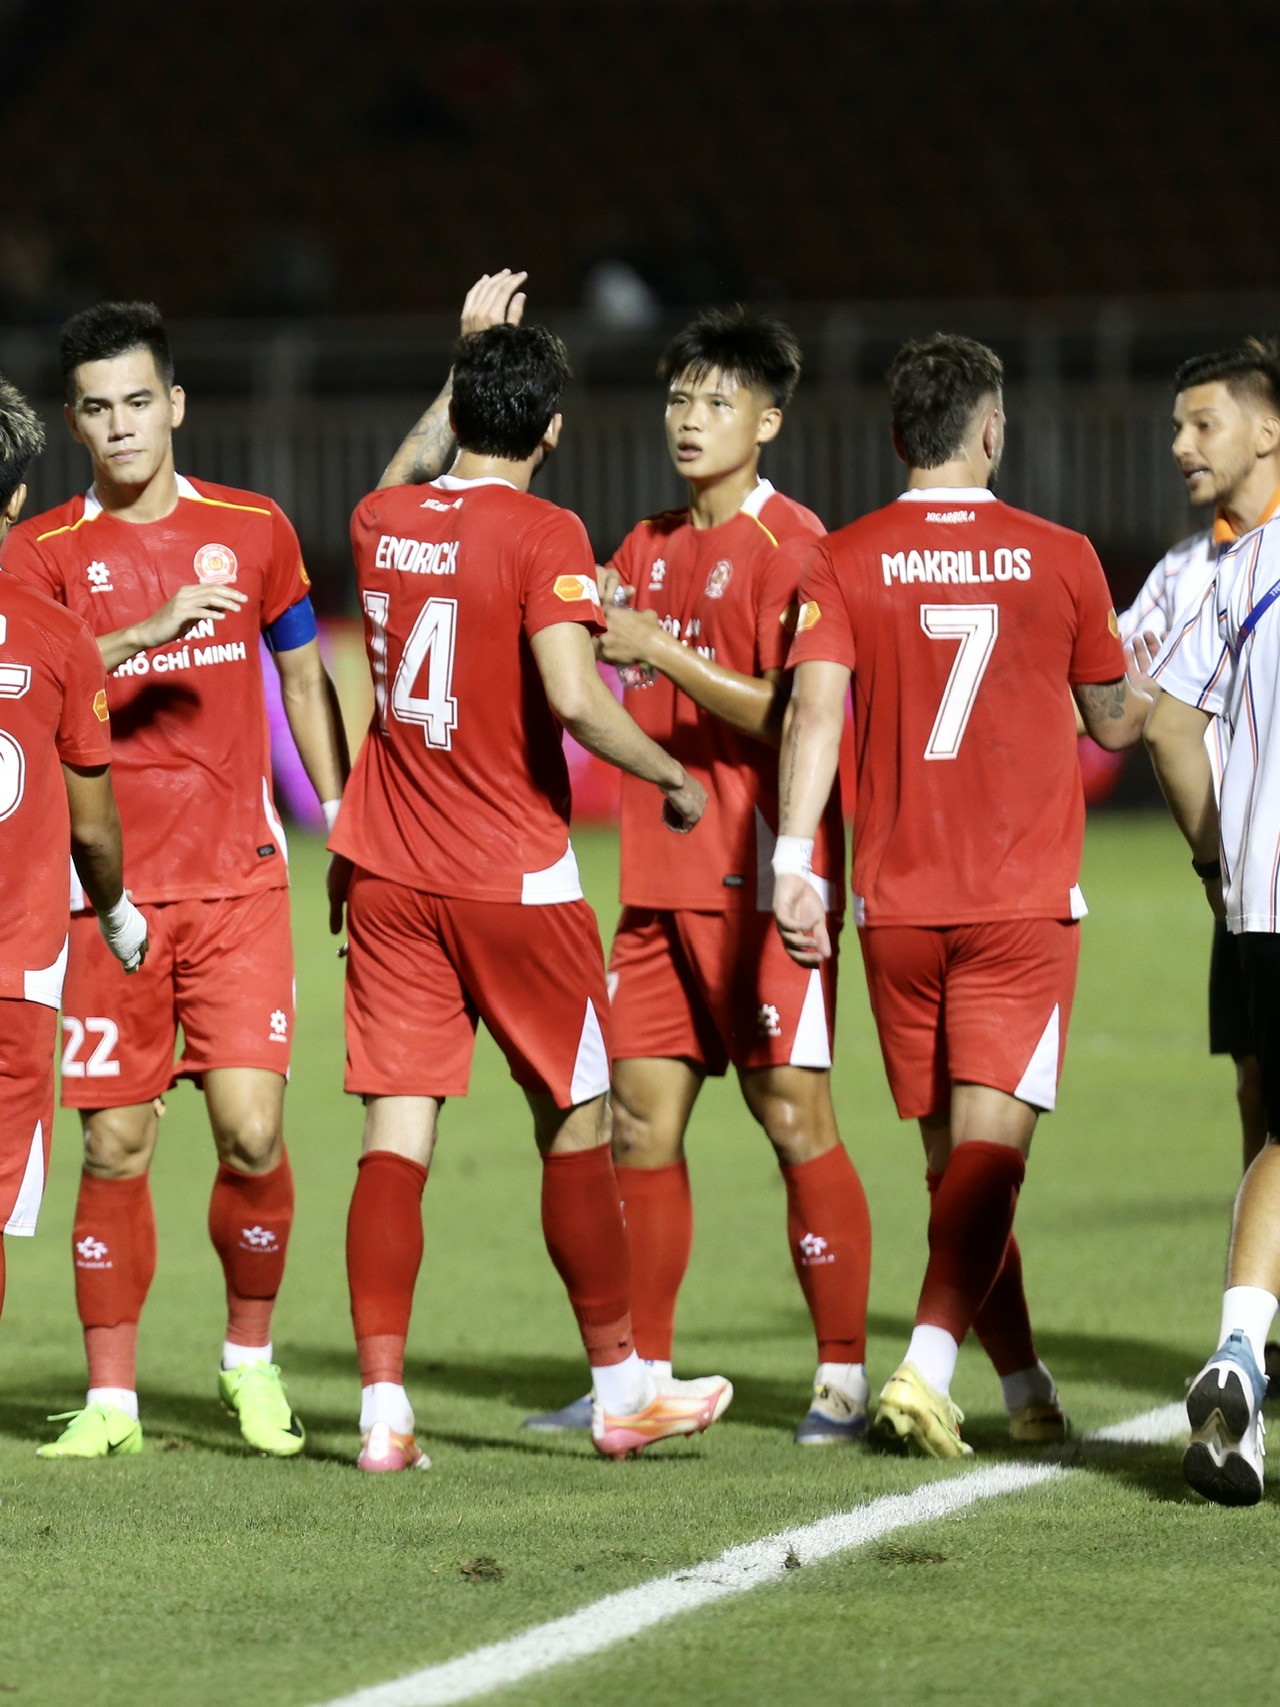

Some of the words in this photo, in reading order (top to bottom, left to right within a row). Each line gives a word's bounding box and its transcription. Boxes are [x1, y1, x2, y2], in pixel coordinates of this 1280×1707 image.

[375, 535, 459, 575] ENDRICK
[881, 547, 1032, 586] MAKRILLOS
[152, 645, 191, 673] CHÍ
[193, 641, 247, 667] MINH
[362, 590, 458, 751] 14
[920, 603, 999, 761] 7
[61, 1015, 121, 1078] 22
